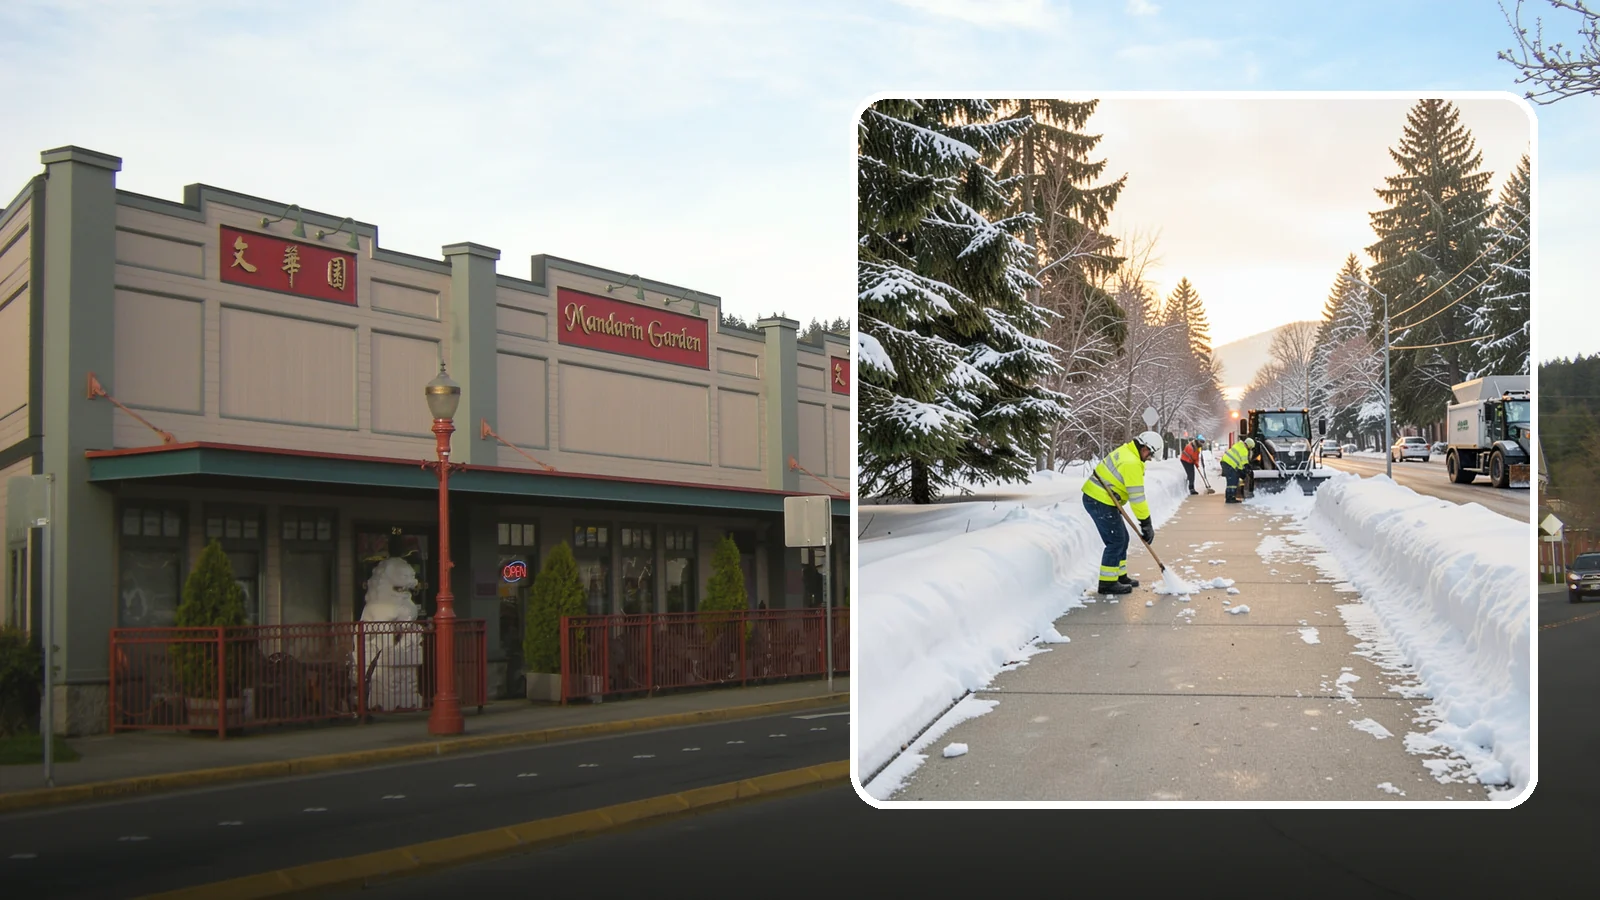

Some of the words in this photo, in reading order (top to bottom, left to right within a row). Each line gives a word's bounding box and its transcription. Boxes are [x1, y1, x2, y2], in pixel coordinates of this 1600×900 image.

[231, 235, 346, 291] 文華園
[564, 302, 644, 341] Mandarin
[648, 320, 701, 352] Garden
[503, 565, 527, 578] OPEN
